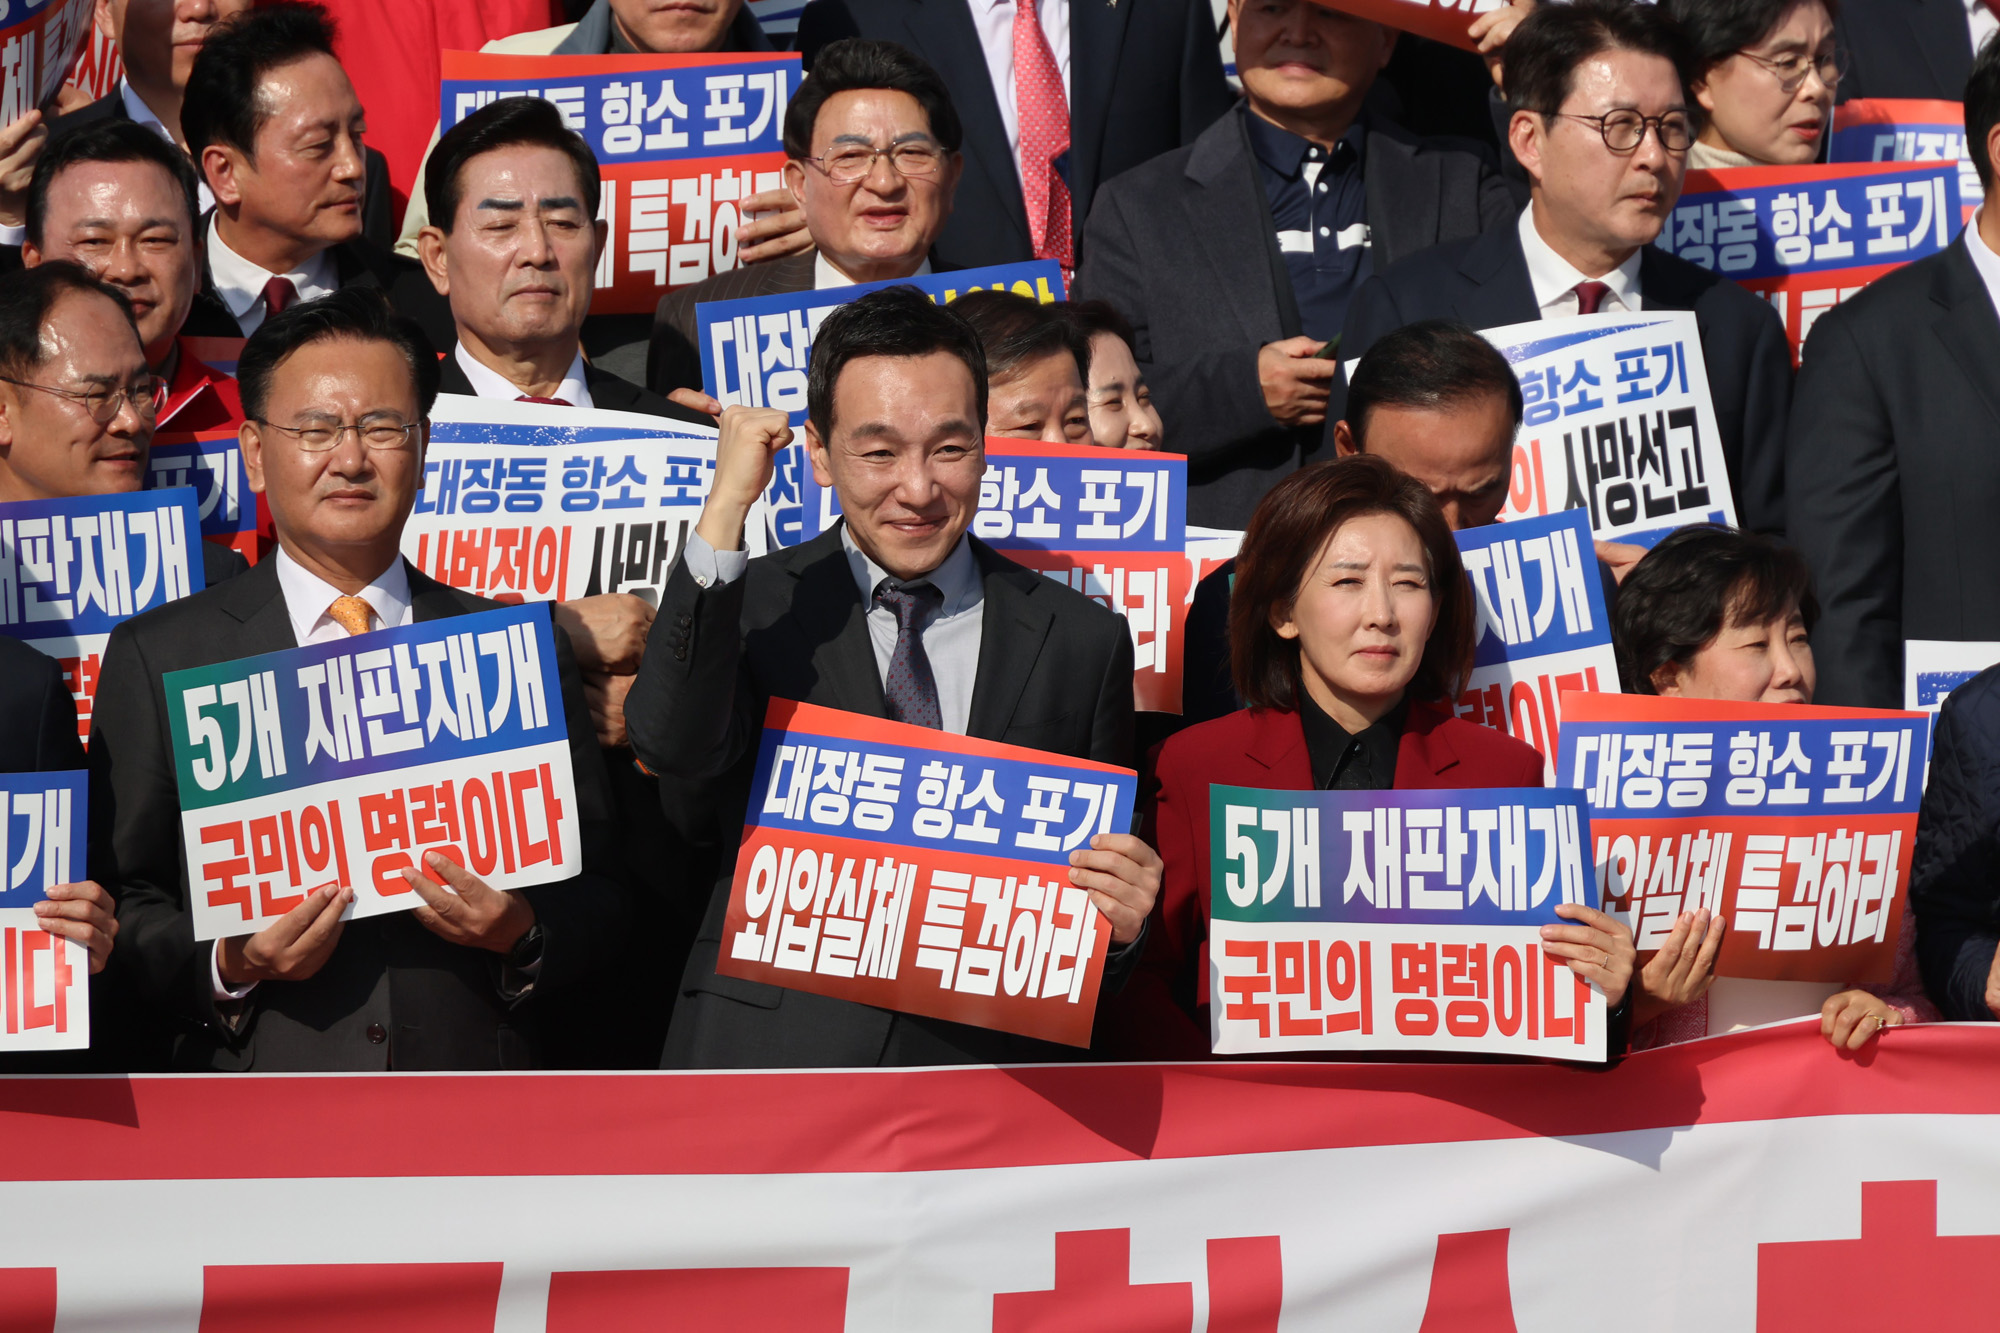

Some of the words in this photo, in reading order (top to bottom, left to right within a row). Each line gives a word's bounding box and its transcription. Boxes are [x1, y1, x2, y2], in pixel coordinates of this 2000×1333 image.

[602, 81, 690, 154] 항소
[703, 69, 788, 146] 포기
[1771, 189, 1854, 266] 항소
[1866, 176, 1949, 254] 포기
[710, 302, 845, 411] 대장
[1519, 358, 1604, 427] 항소
[1614, 340, 1690, 404] 포기
[414, 457, 548, 516] 대장동
[560, 454, 648, 513] 항소
[660, 453, 717, 508] 포
[972, 464, 1061, 539] 항소
[1075, 469, 1170, 541] 포기
[1562, 405, 1712, 532] 사망선고
[182, 670, 288, 792] 5개
[296, 621, 550, 766] 재판재개
[762, 744, 906, 832] 대장동
[911, 759, 1006, 845] 항소
[1014, 774, 1119, 853] 포기
[1573, 731, 1714, 809] 대장동
[1725, 730, 1812, 806] 항소
[1822, 728, 1913, 804] 포기
[0, 788, 72, 892] 개
[199, 799, 355, 922] 국민의
[358, 762, 564, 897] 명령이다
[1224, 803, 1321, 908] 5개
[1342, 804, 1587, 911] 재판재개
[1733, 827, 1903, 951] 특검하라
[730, 844, 919, 980] 외압실체
[915, 869, 1098, 1004] 특검하라
[1223, 939, 1374, 1039] 국민의
[1390, 941, 1592, 1045] 명령이다
